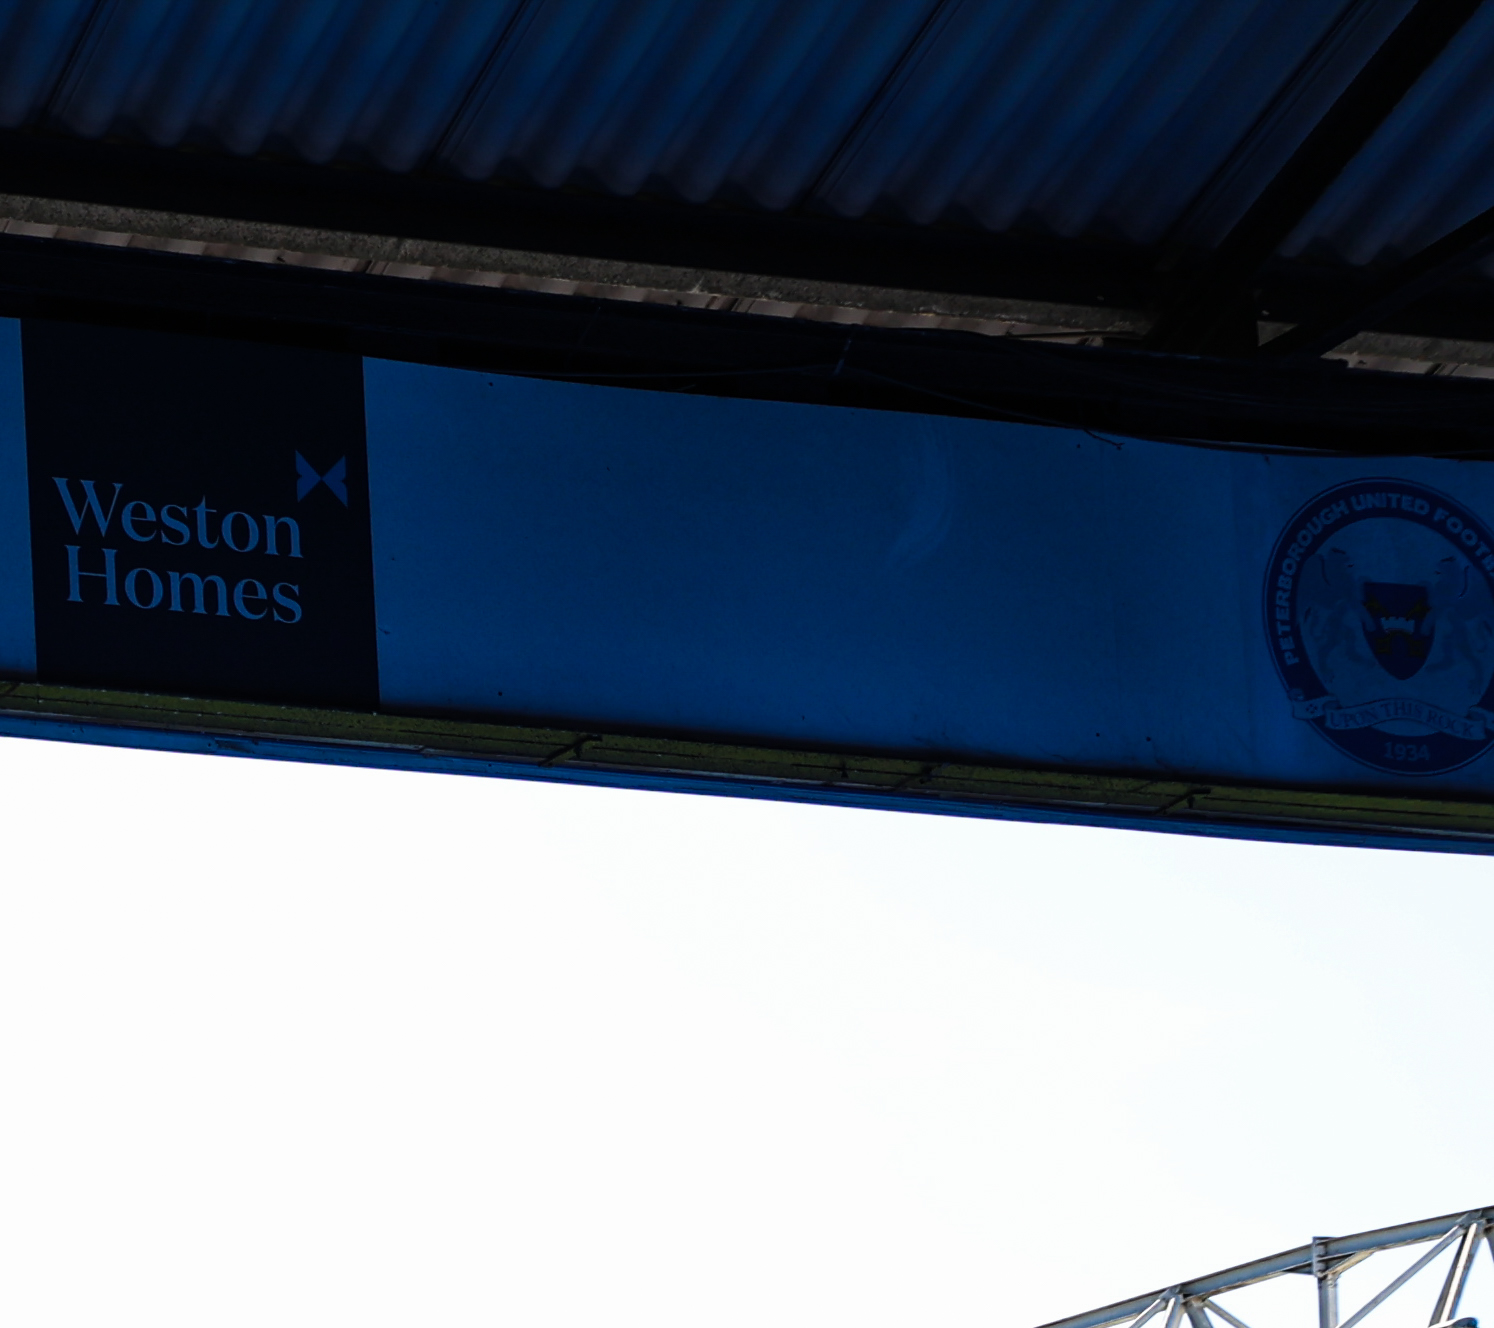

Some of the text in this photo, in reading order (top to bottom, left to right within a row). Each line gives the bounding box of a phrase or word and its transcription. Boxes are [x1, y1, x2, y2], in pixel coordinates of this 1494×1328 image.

[51, 476, 304, 558] Weston
[1351, 491, 1431, 516] UNITED
[64, 543, 303, 624] Homes
[1383, 741, 1431, 762] 1934
